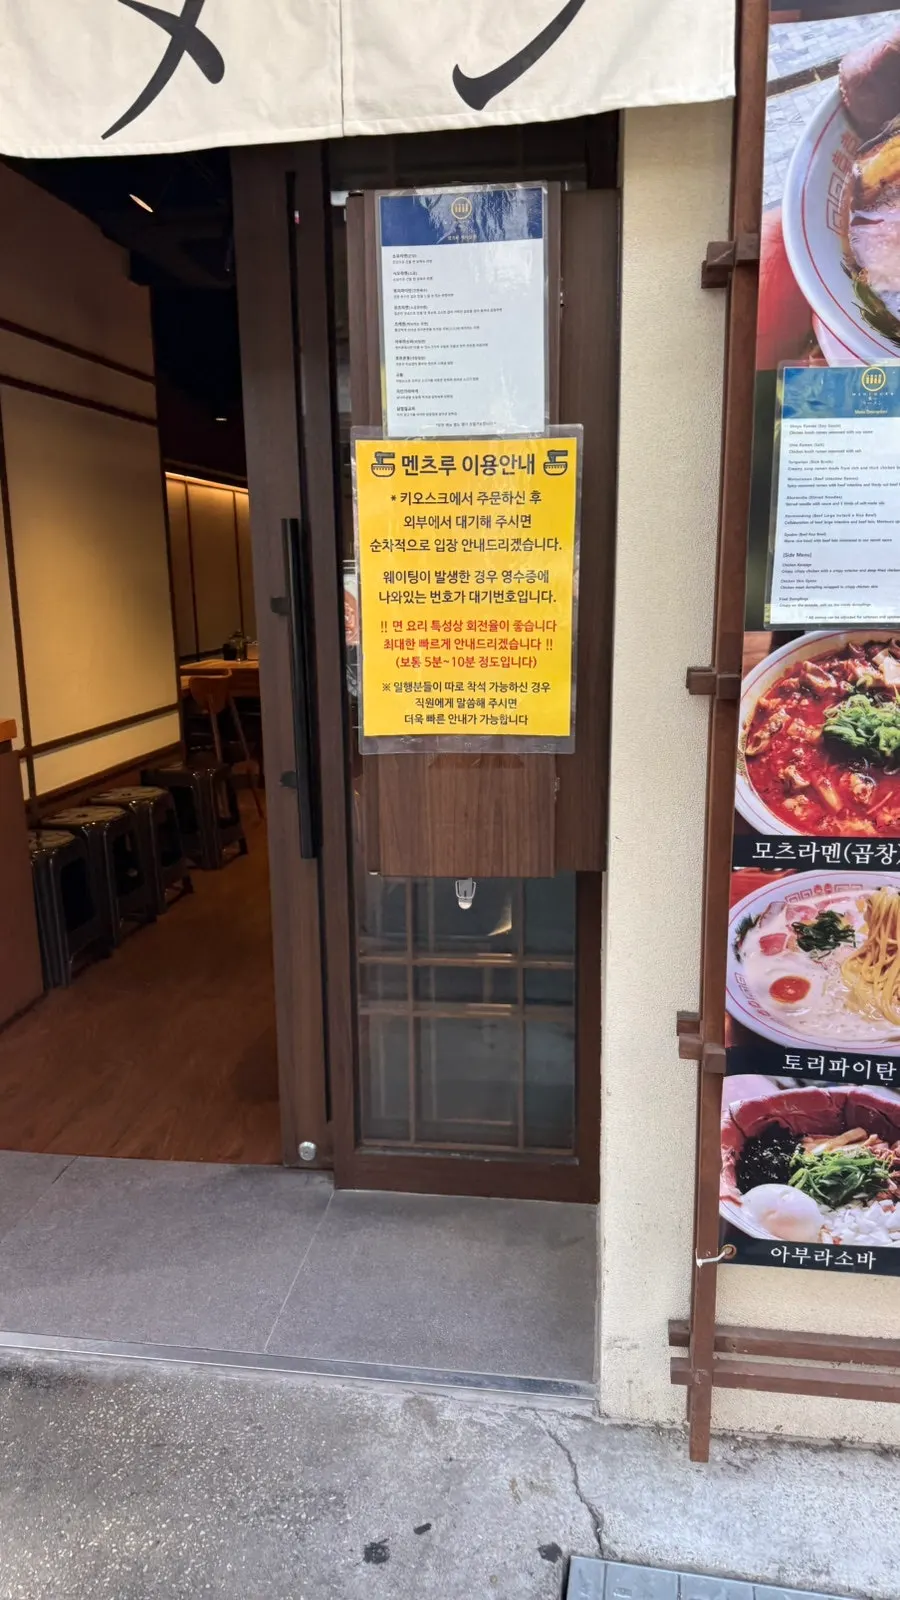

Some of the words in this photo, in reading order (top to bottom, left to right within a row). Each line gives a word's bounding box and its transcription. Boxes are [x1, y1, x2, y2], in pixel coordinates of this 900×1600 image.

[402, 455, 457, 476] 멘츠루
[462, 453, 535, 476] 이용안내
[401, 491, 473, 505] 키오스크에서
[477, 491, 526, 505] 주문하신
[529, 490, 542, 504] 후
[404, 515, 452, 529] 외부에서
[456, 515, 492, 529] 대기해
[496, 515, 532, 529] 주시면
[370, 539, 431, 552] 순차적으로
[434, 538, 458, 552] 입장
[462, 537, 562, 552] 안내드리겠습니다.
[383, 570, 430, 584] 웨이팅이
[434, 570, 470, 584] 발생한
[474, 570, 498, 584] 경우
[501, 569, 549, 583] 영수증에
[379, 590, 427, 604] 나와있는
[430, 590, 466, 604] 번호가
[469, 590, 557, 604] 대기번호입니다.
[380, 621, 388, 633] !!
[392, 620, 403, 632] 면
[406, 620, 428, 632] 요리
[431, 620, 463, 632] 특성상
[466, 620, 510, 632] 회전율이
[512, 620, 557, 632] 좋습니다
[383, 638, 416, 650] 최대한
[419, 638, 451, 650] 빠르게
[454, 638, 542, 650] 안내드리겠습니다
[545, 639, 553, 651] !!
[395, 656, 421, 668] (보통
[424, 656, 476, 668] 5분~10분
[478, 656, 538, 669] 정도입니다)
[393, 682, 442, 693] 일행분들이
[444, 682, 464, 693] 따로
[467, 682, 486, 693] 착석
[489, 682, 528, 693] 가능하신
[531, 682, 551, 693] 경우
[415, 698, 454, 709] 직원에게
[456, 698, 486, 709] 말씀해
[488, 698, 517, 709] 주시면
[404, 714, 424, 725] 더욱
[426, 714, 446, 725] 빠른
[448, 714, 478, 725] 안내가
[480, 714, 528, 725] 가능합니다
[782, 1054, 897, 1081] 토리파이탄
[770, 1245, 877, 1270] 아부라소바
